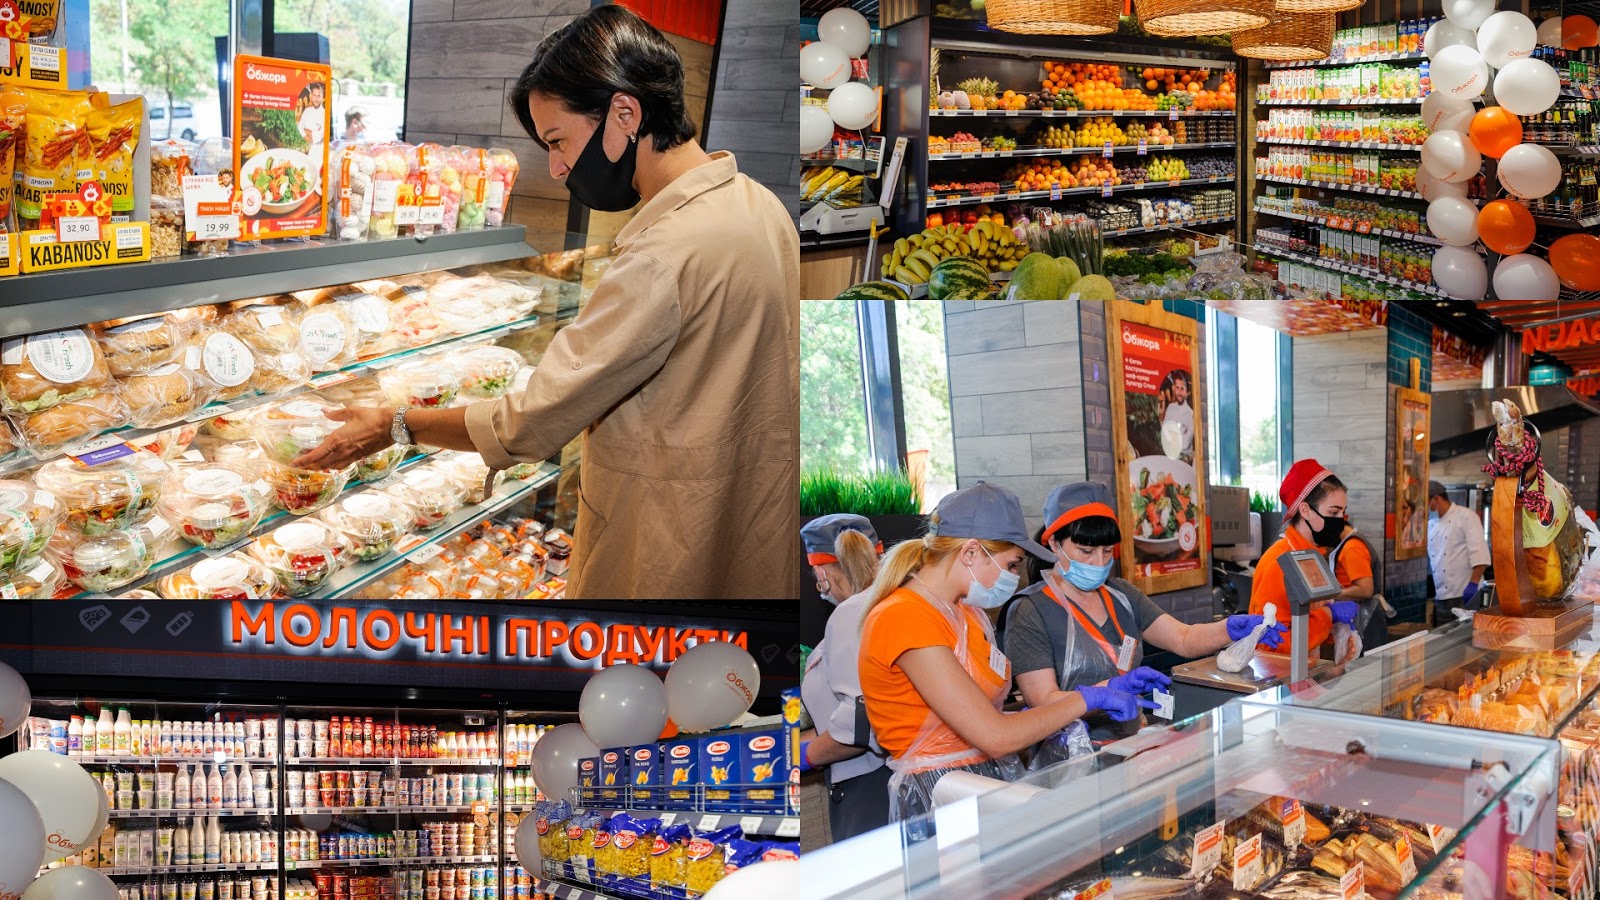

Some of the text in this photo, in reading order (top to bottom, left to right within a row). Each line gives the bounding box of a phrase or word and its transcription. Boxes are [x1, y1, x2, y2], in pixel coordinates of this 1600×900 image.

[18, 2, 54, 16] ANOSY
[246, 67, 287, 84] Обжора
[103, 182, 128, 196] NOSY
[31, 241, 111, 266] KABANOSY
[1123, 330, 1160, 351] Обжора
[231, 600, 490, 655] МОЛОЧНІ
